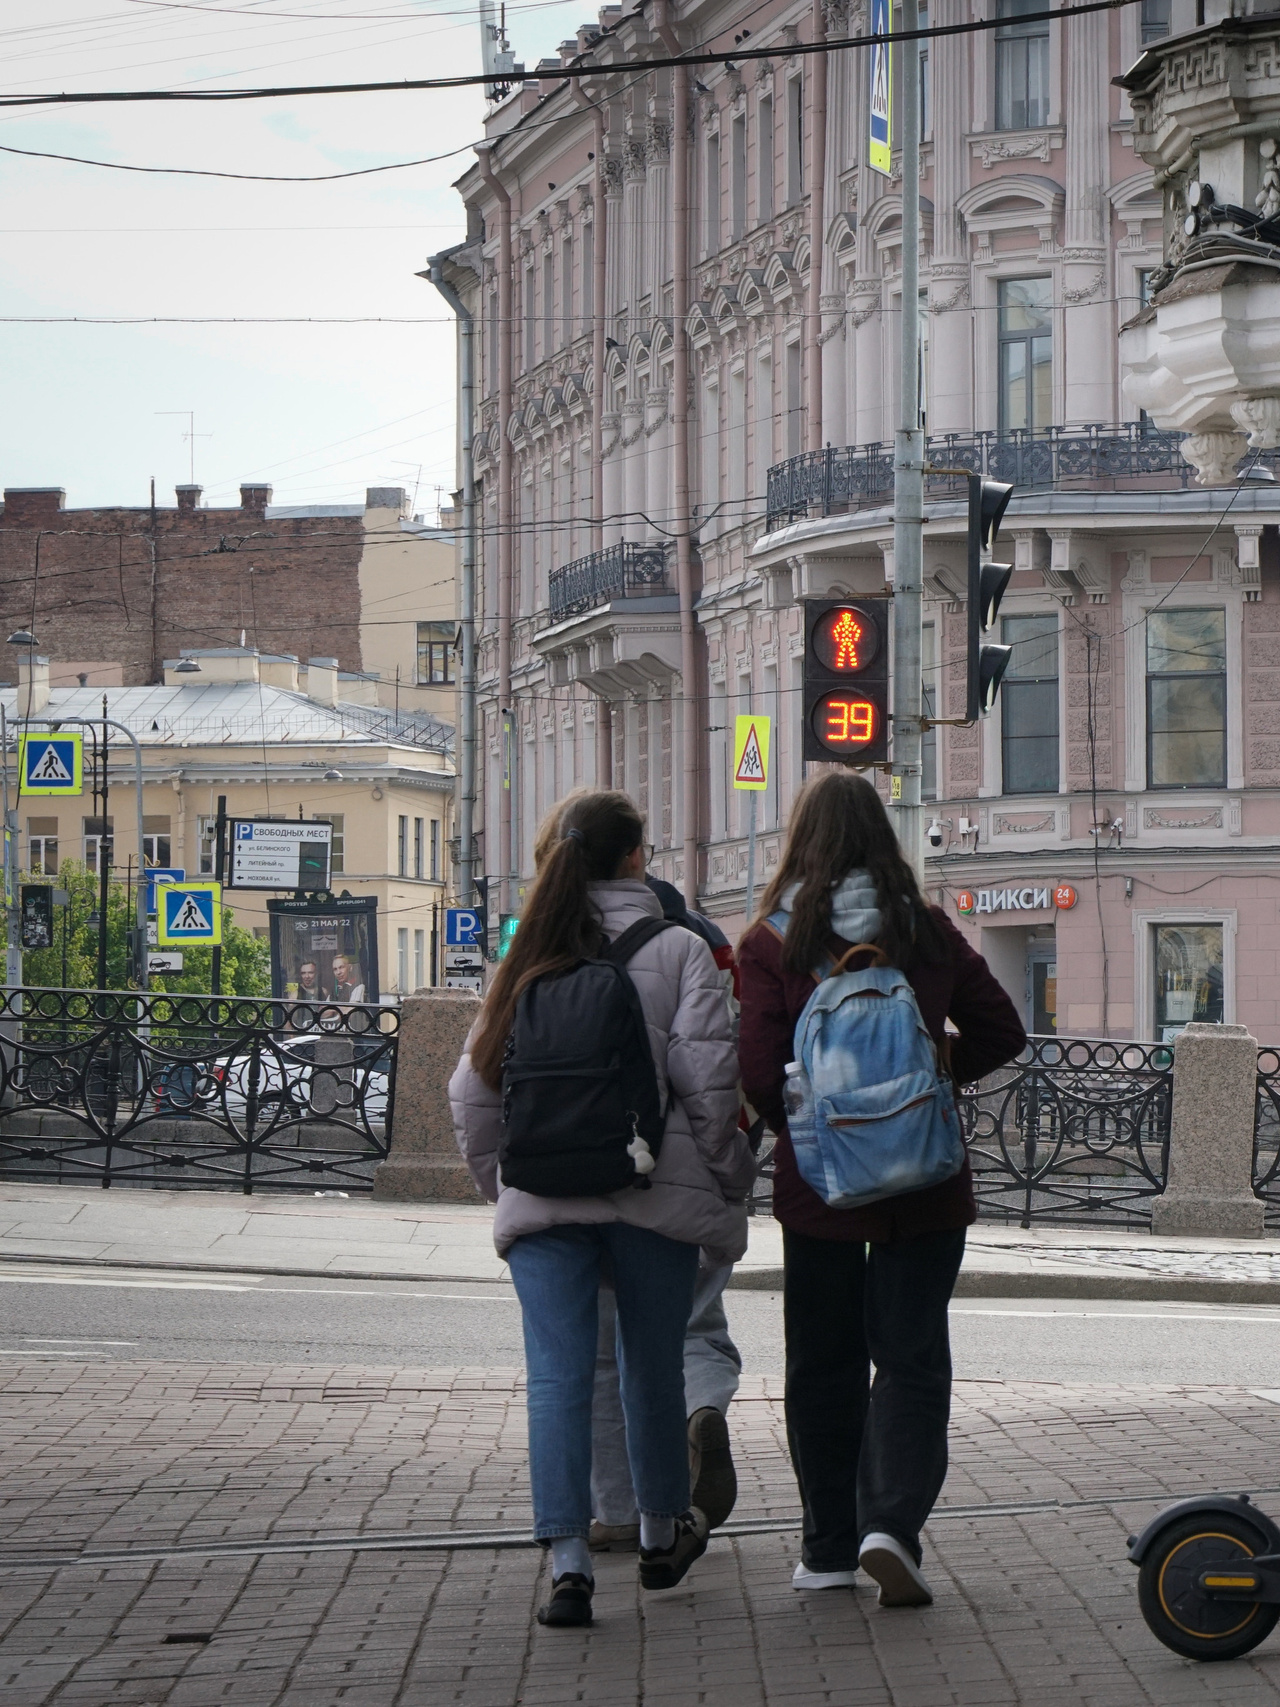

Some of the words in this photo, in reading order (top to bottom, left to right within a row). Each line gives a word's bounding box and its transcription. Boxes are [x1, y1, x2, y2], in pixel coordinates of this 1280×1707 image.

[827, 701, 873, 741] 39
[254, 828, 304, 837] СВОБОДНЫХ
[306, 830, 330, 838] МЕСТ
[976, 887, 1049, 914] ДИКСИ
[1057, 888, 1070, 899] 24
[320, 919, 339, 927] МАЯ
[456, 912, 476, 942] P
